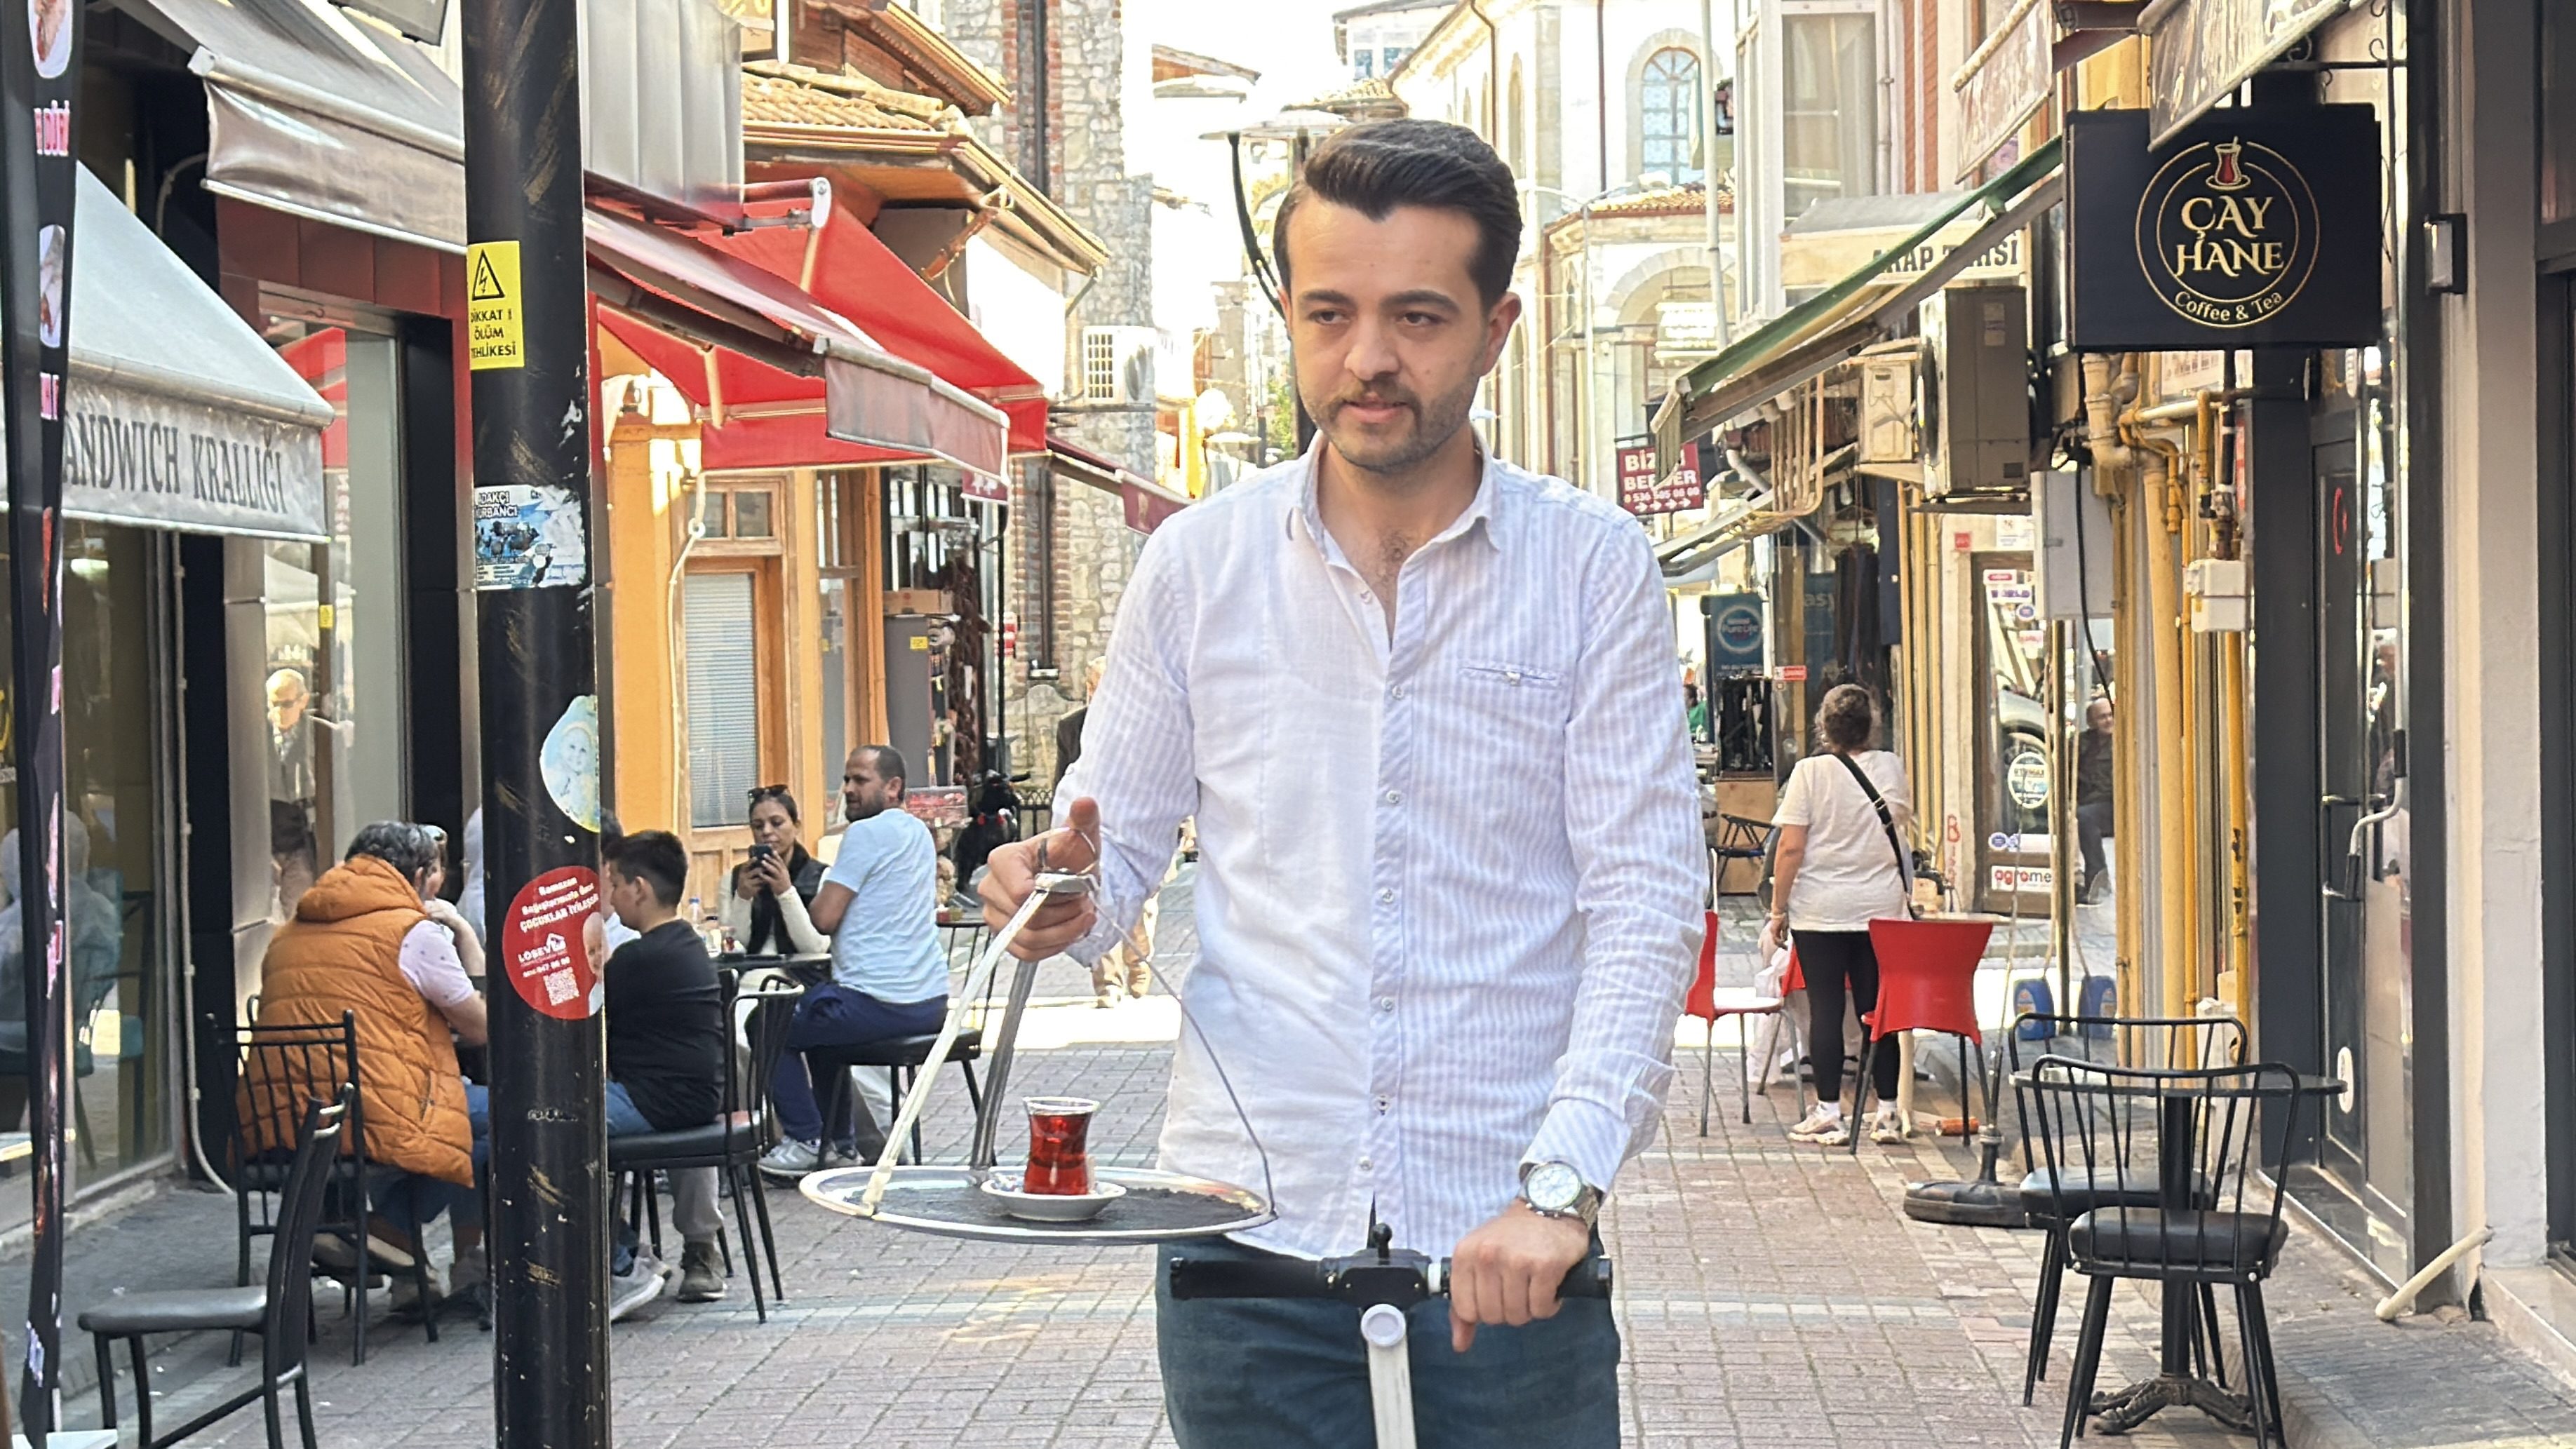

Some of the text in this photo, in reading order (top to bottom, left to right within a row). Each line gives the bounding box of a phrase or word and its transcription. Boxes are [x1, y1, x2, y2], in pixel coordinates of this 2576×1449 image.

[2180, 195, 2274, 239] ÇAY
[2175, 238, 2285, 277] HANE
[2175, 290, 2283, 321] Coffee & Tea
[474, 325, 504, 340] ÖLÜM
[1625, 449, 1685, 472] BİZ
[1623, 470, 1697, 491] BERER
